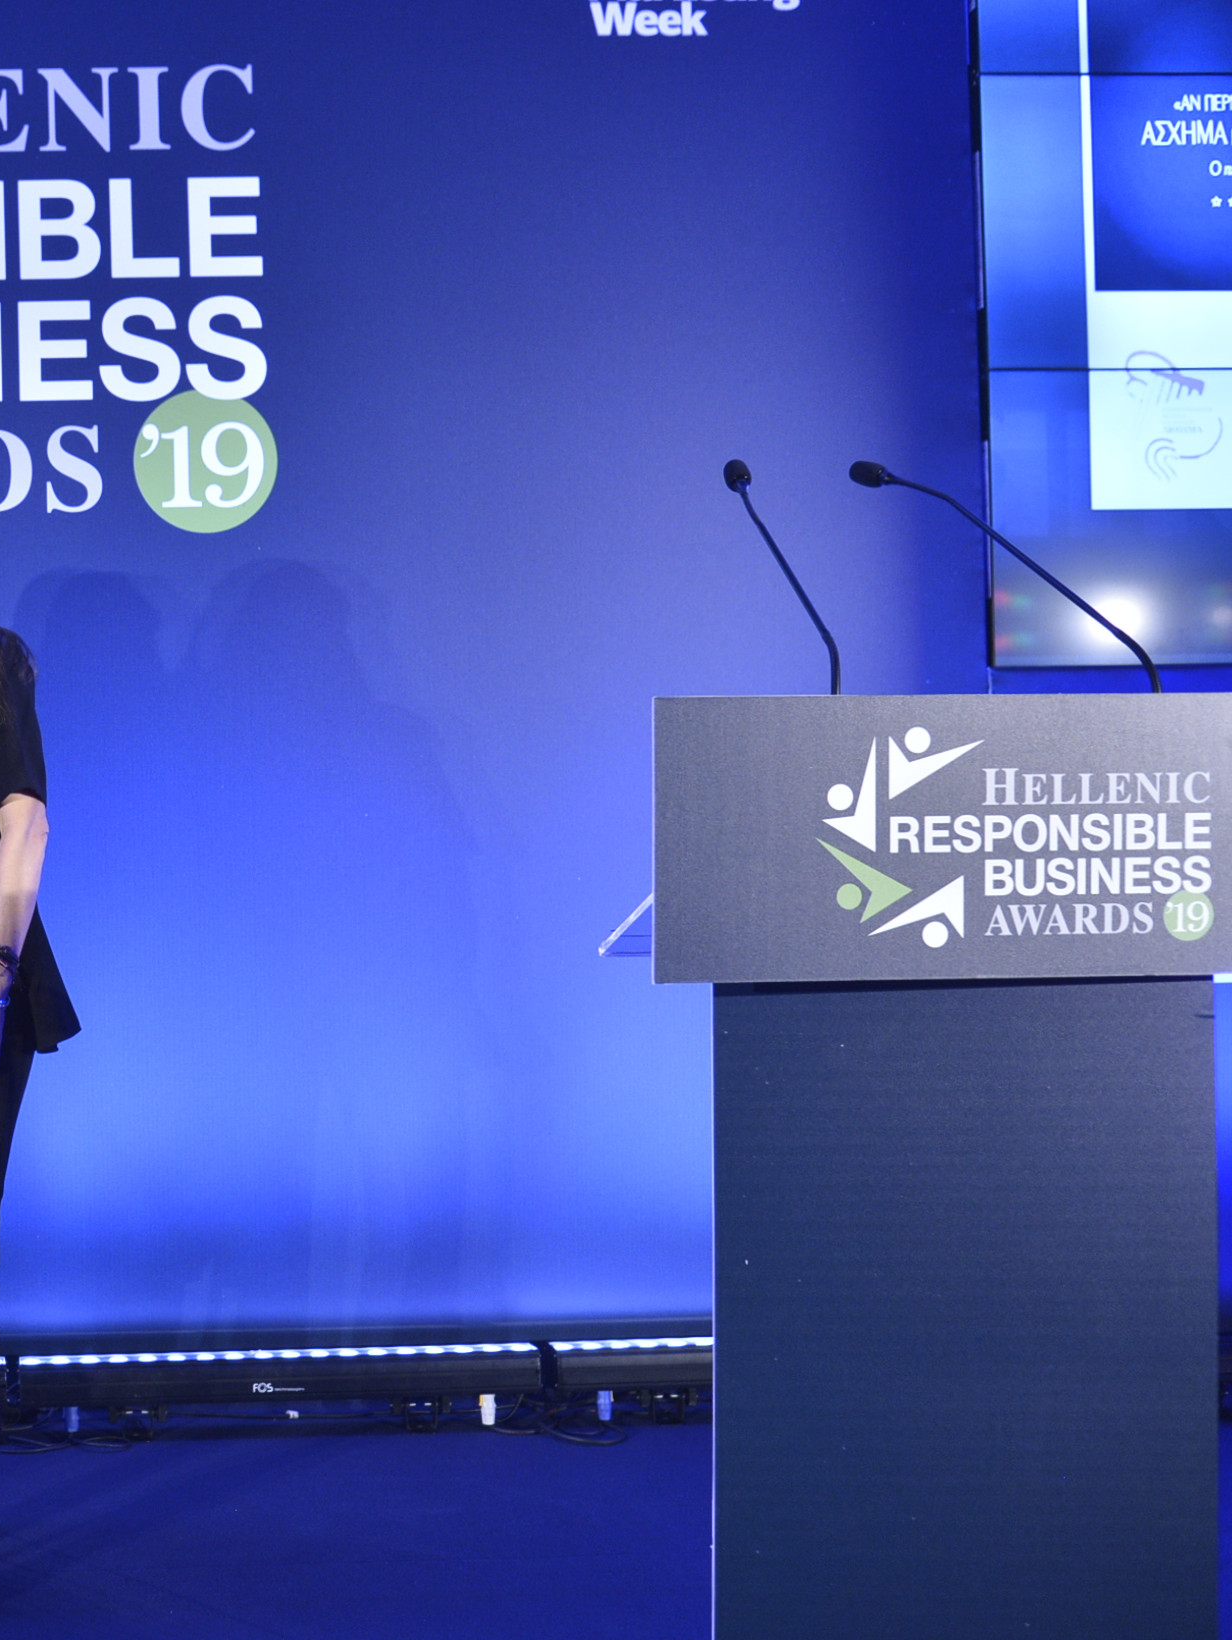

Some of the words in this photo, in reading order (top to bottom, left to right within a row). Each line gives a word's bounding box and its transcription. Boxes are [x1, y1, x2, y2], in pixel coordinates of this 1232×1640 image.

[590, 1, 709, 37] Week
[1140, 119, 1229, 146] ΑΣΧΗΜΑ
[982, 767, 1212, 807] HELLENIC
[889, 812, 1213, 854] RESPONSIBLE
[984, 855, 1213, 897] BUSINESS
[984, 902, 1155, 937] AWARDS
[252, 1382, 274, 1393] FOS
